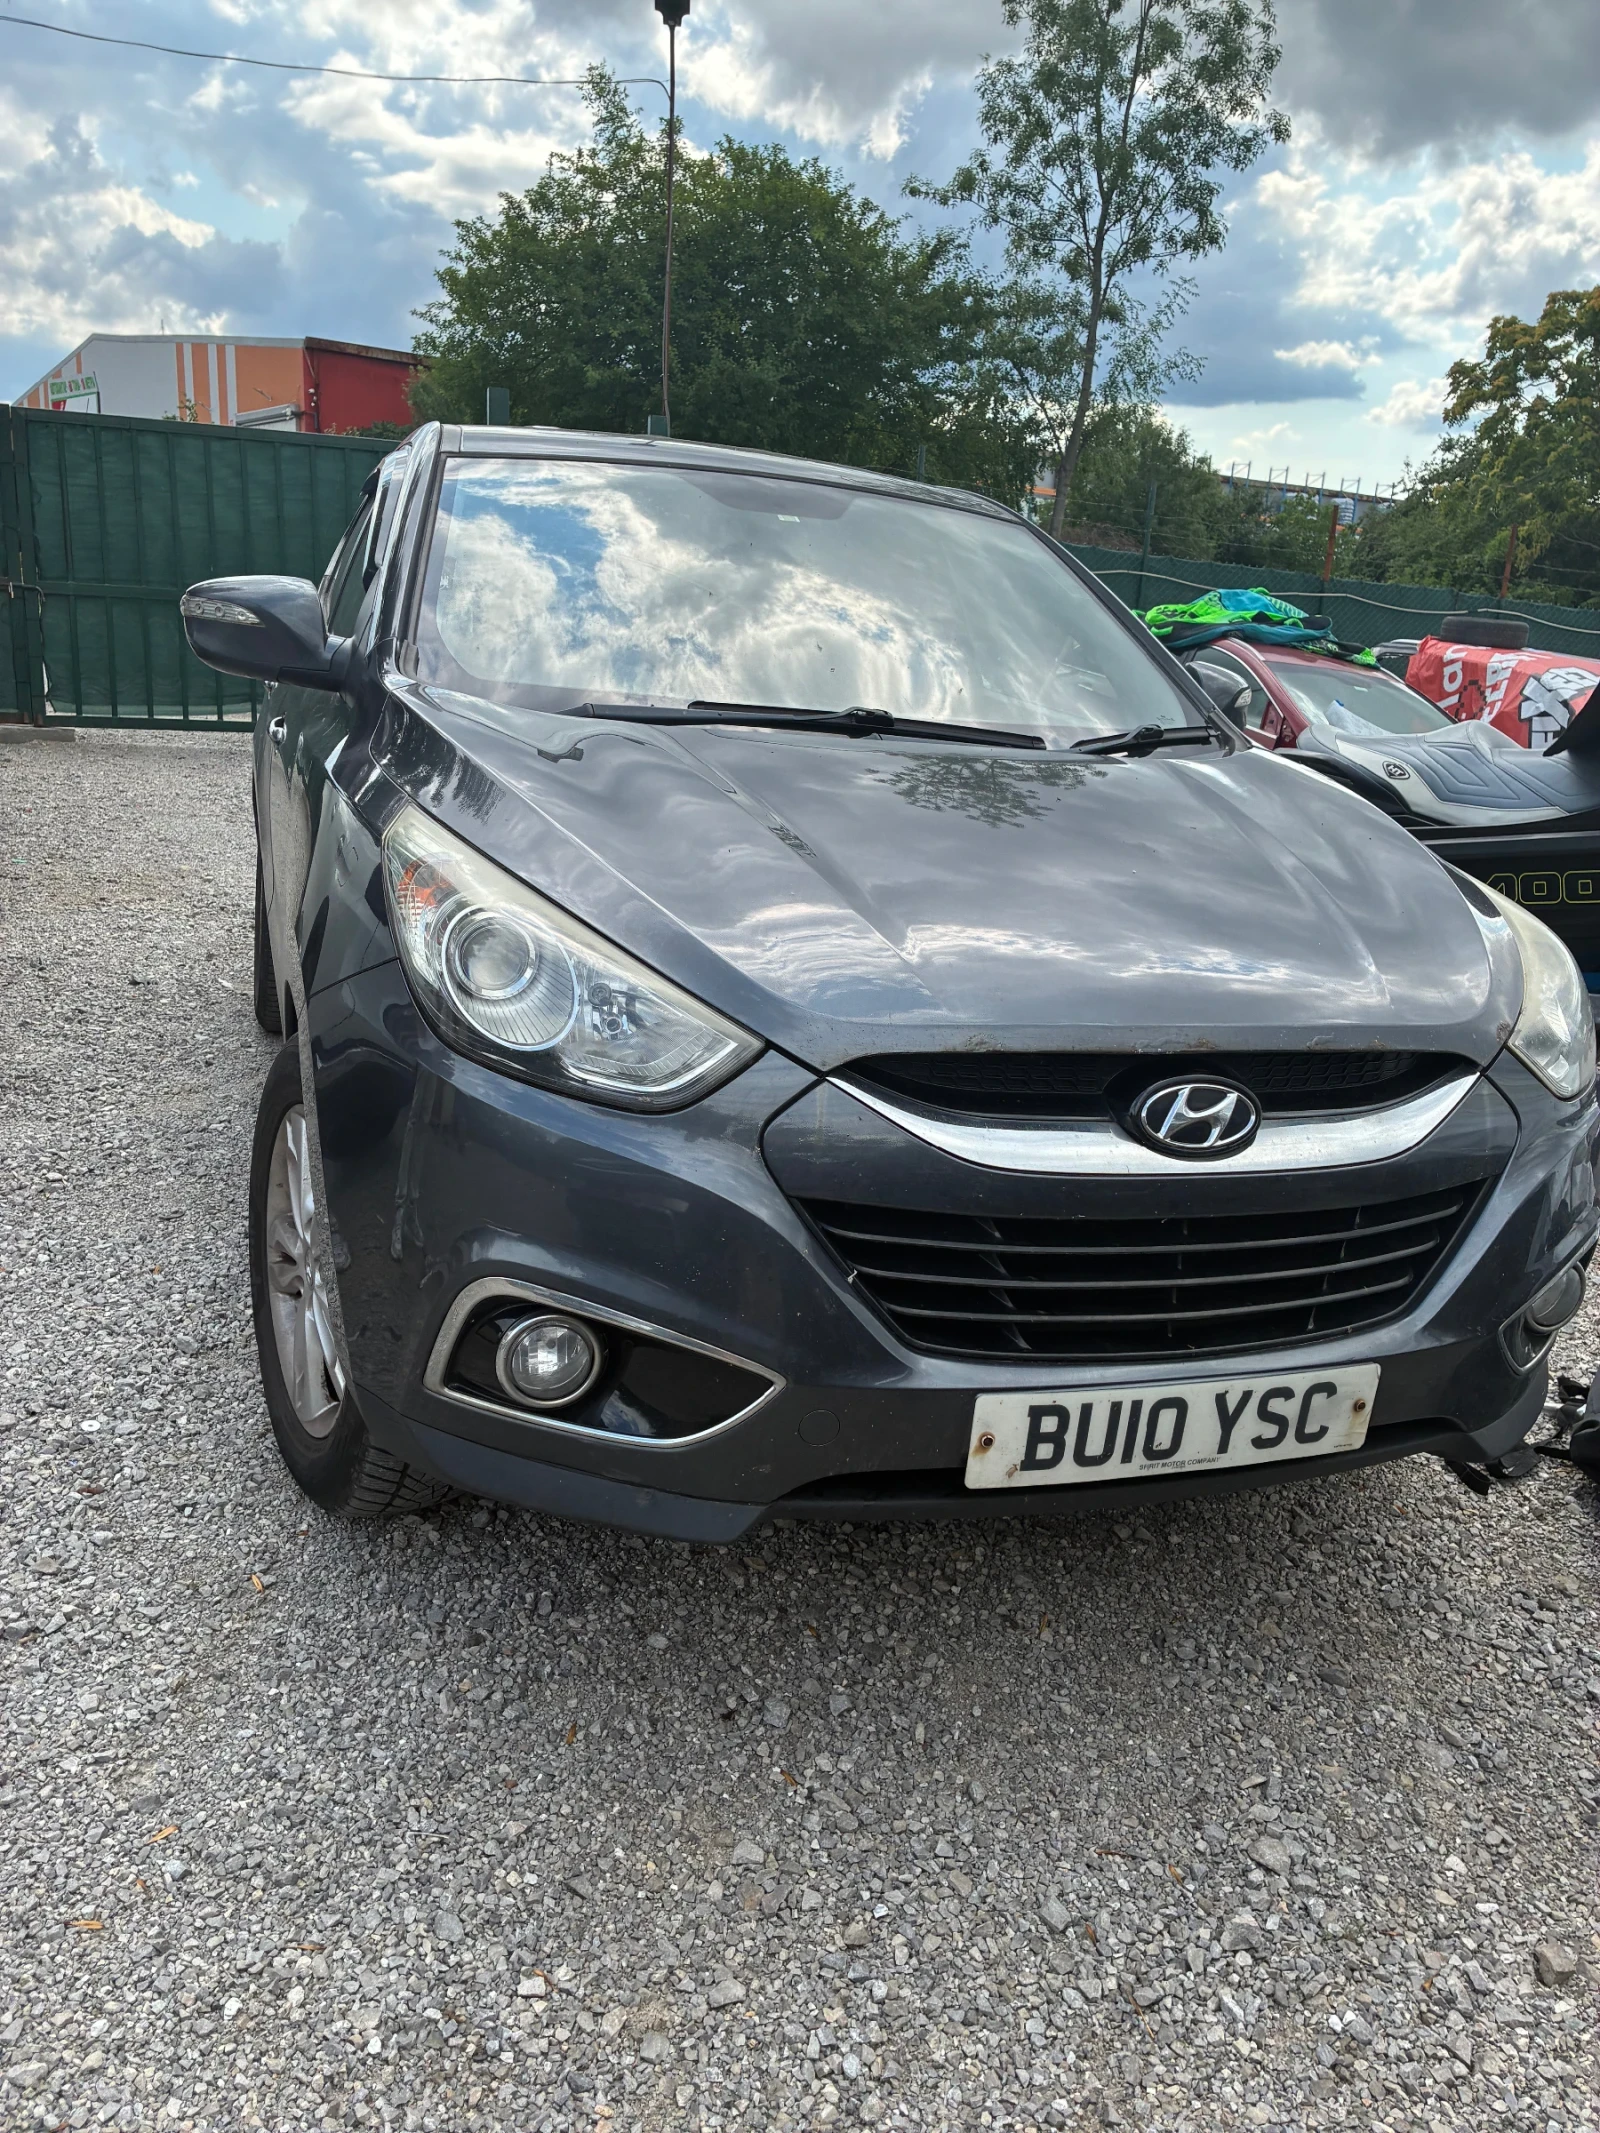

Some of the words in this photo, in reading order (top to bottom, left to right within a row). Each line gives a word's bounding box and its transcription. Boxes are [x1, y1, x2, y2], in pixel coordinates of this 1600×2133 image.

[1019, 1396, 1189, 1471] BU10
[1215, 1381, 1338, 1454] YSC
[1139, 1462, 1160, 1471] SPIRIT
[1161, 1460, 1185, 1468] MOTOR
[1187, 1457, 1221, 1466] COMPANY
